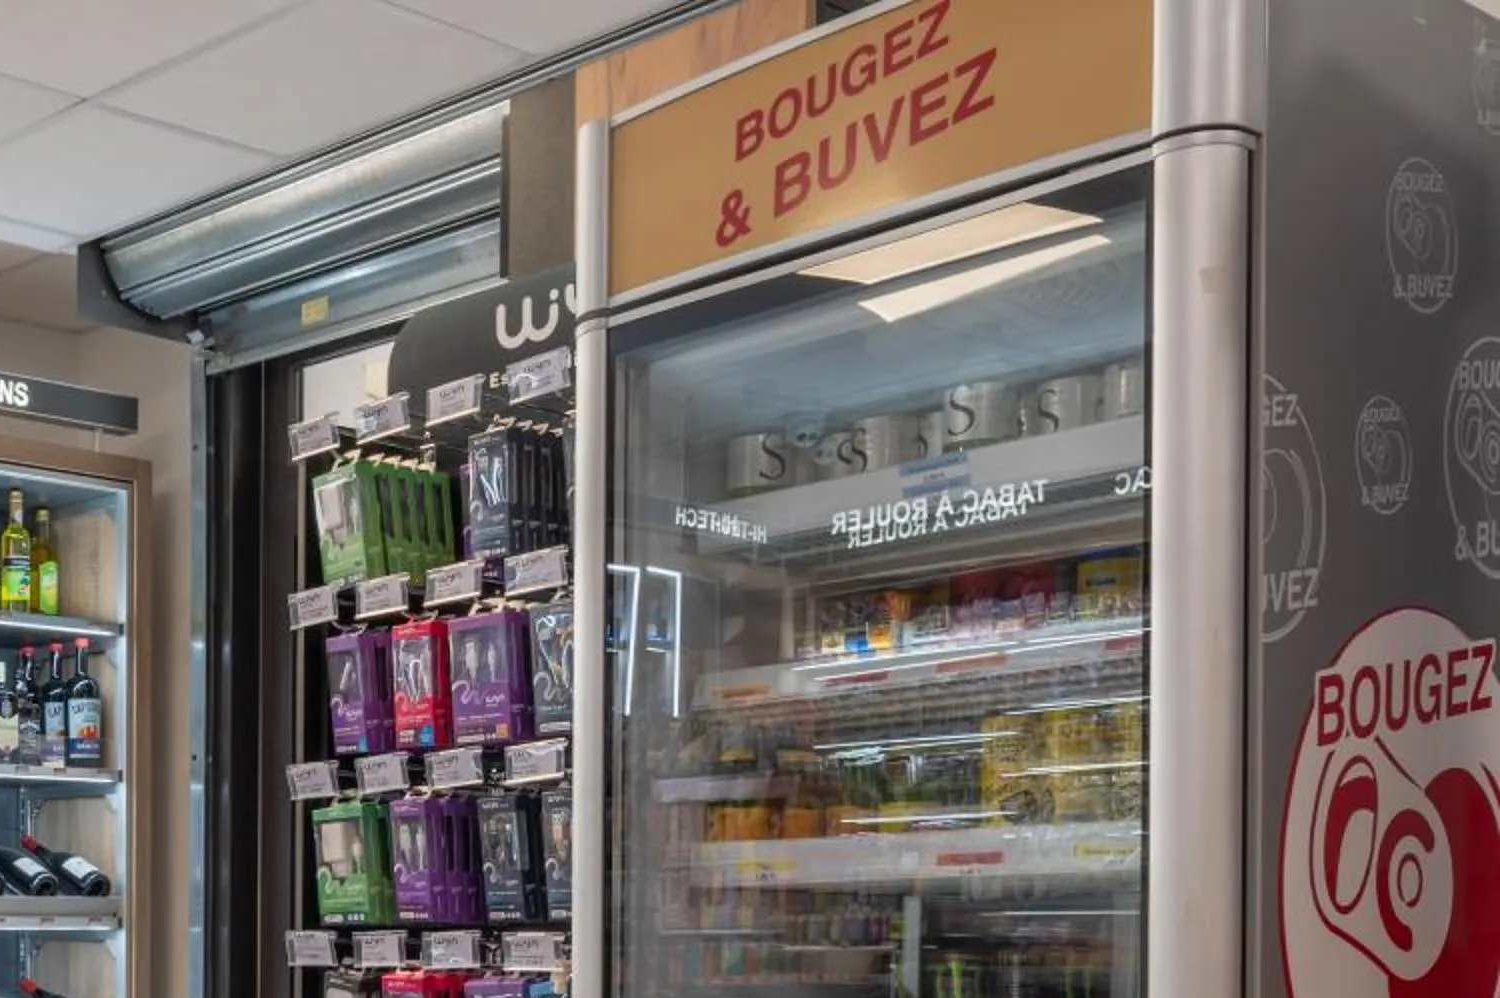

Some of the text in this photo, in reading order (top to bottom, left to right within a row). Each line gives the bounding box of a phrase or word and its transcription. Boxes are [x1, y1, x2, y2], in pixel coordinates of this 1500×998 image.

[735, 0, 950, 161] BOUGEZ
[715, 48, 997, 248] & BUVEZ
[1395, 172, 1443, 192] BOUGEZ
[1408, 273, 1453, 298] BUVEZ
[1266, 568, 1319, 612] VEZ
[1316, 642, 1494, 748] BOUGEZ
